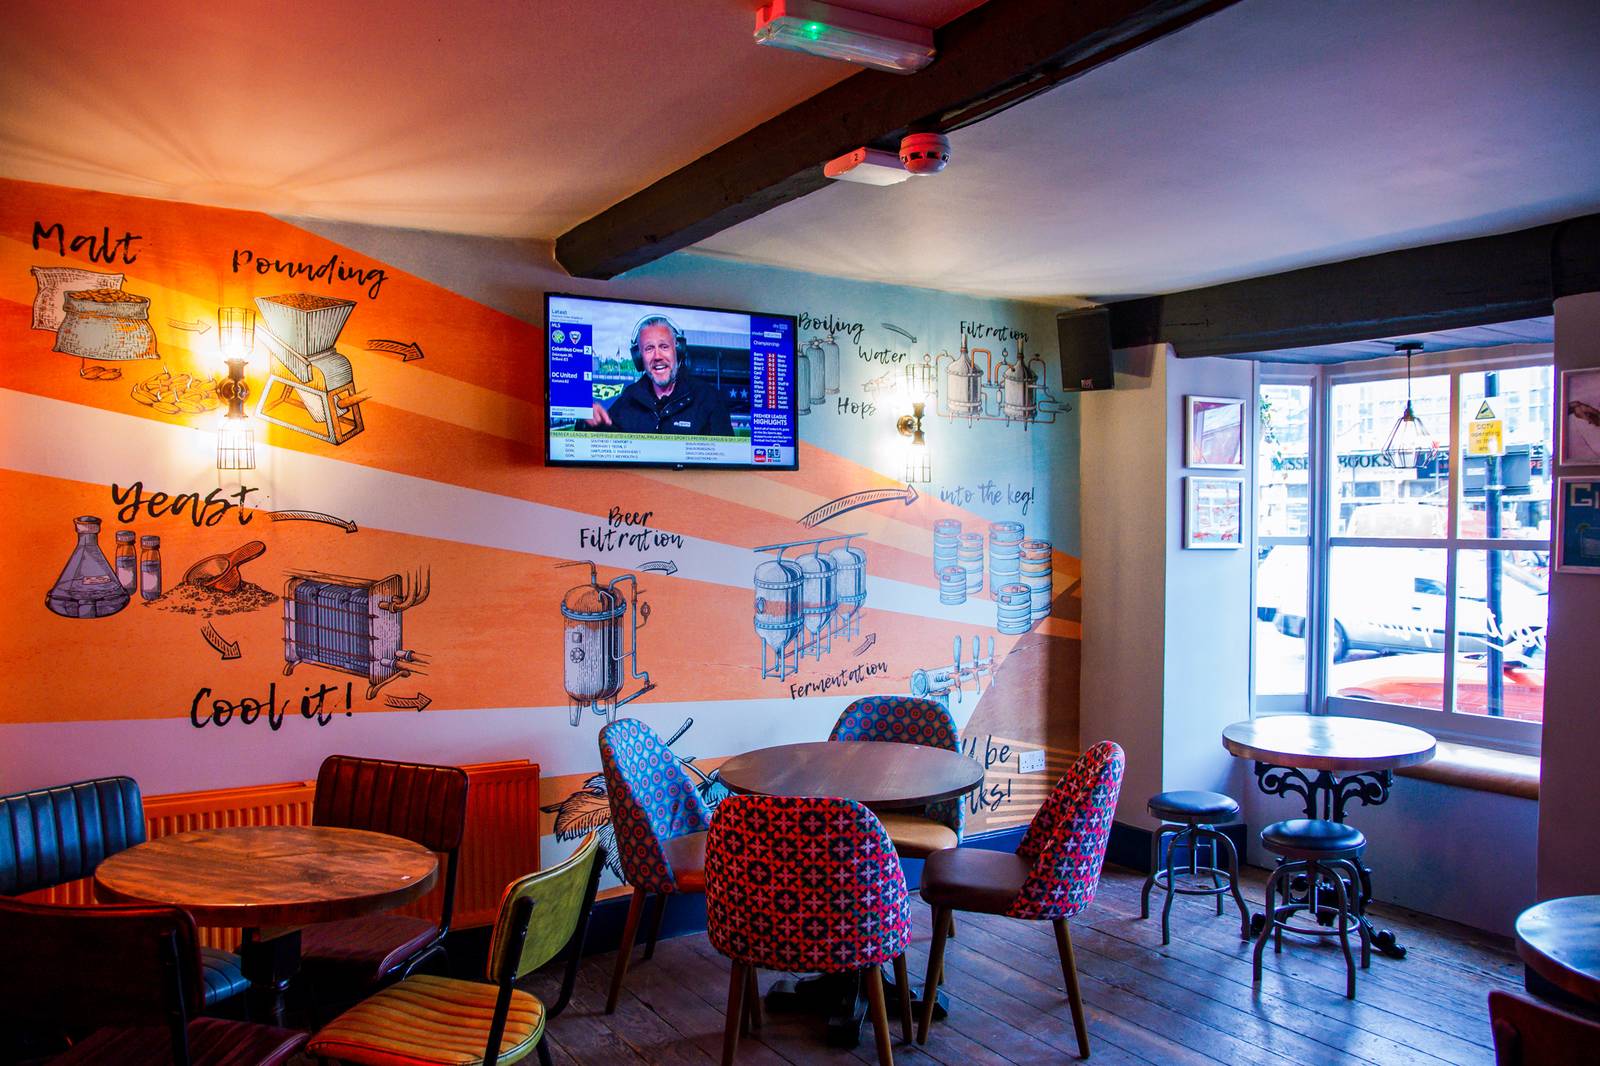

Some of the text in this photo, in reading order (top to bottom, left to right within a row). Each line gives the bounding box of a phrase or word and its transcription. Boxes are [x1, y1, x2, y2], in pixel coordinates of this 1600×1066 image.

[32, 221, 143, 264] Malt
[232, 249, 389, 299] Pounding
[798, 311, 865, 345] Boiling
[960, 320, 1030, 343] Filtration
[858, 346, 907, 365] Water
[560, 371, 578, 379] United
[838, 397, 877, 419] Hops
[1338, 453, 1391, 469] BOOKS
[940, 479, 1035, 516] into the keg!
[608, 506, 654, 527] Beer
[580, 527, 684, 549] Filtration
[789, 660, 889, 700] Fermentation
[190, 682, 290, 731] Cool
[985, 733, 1013, 770] be
